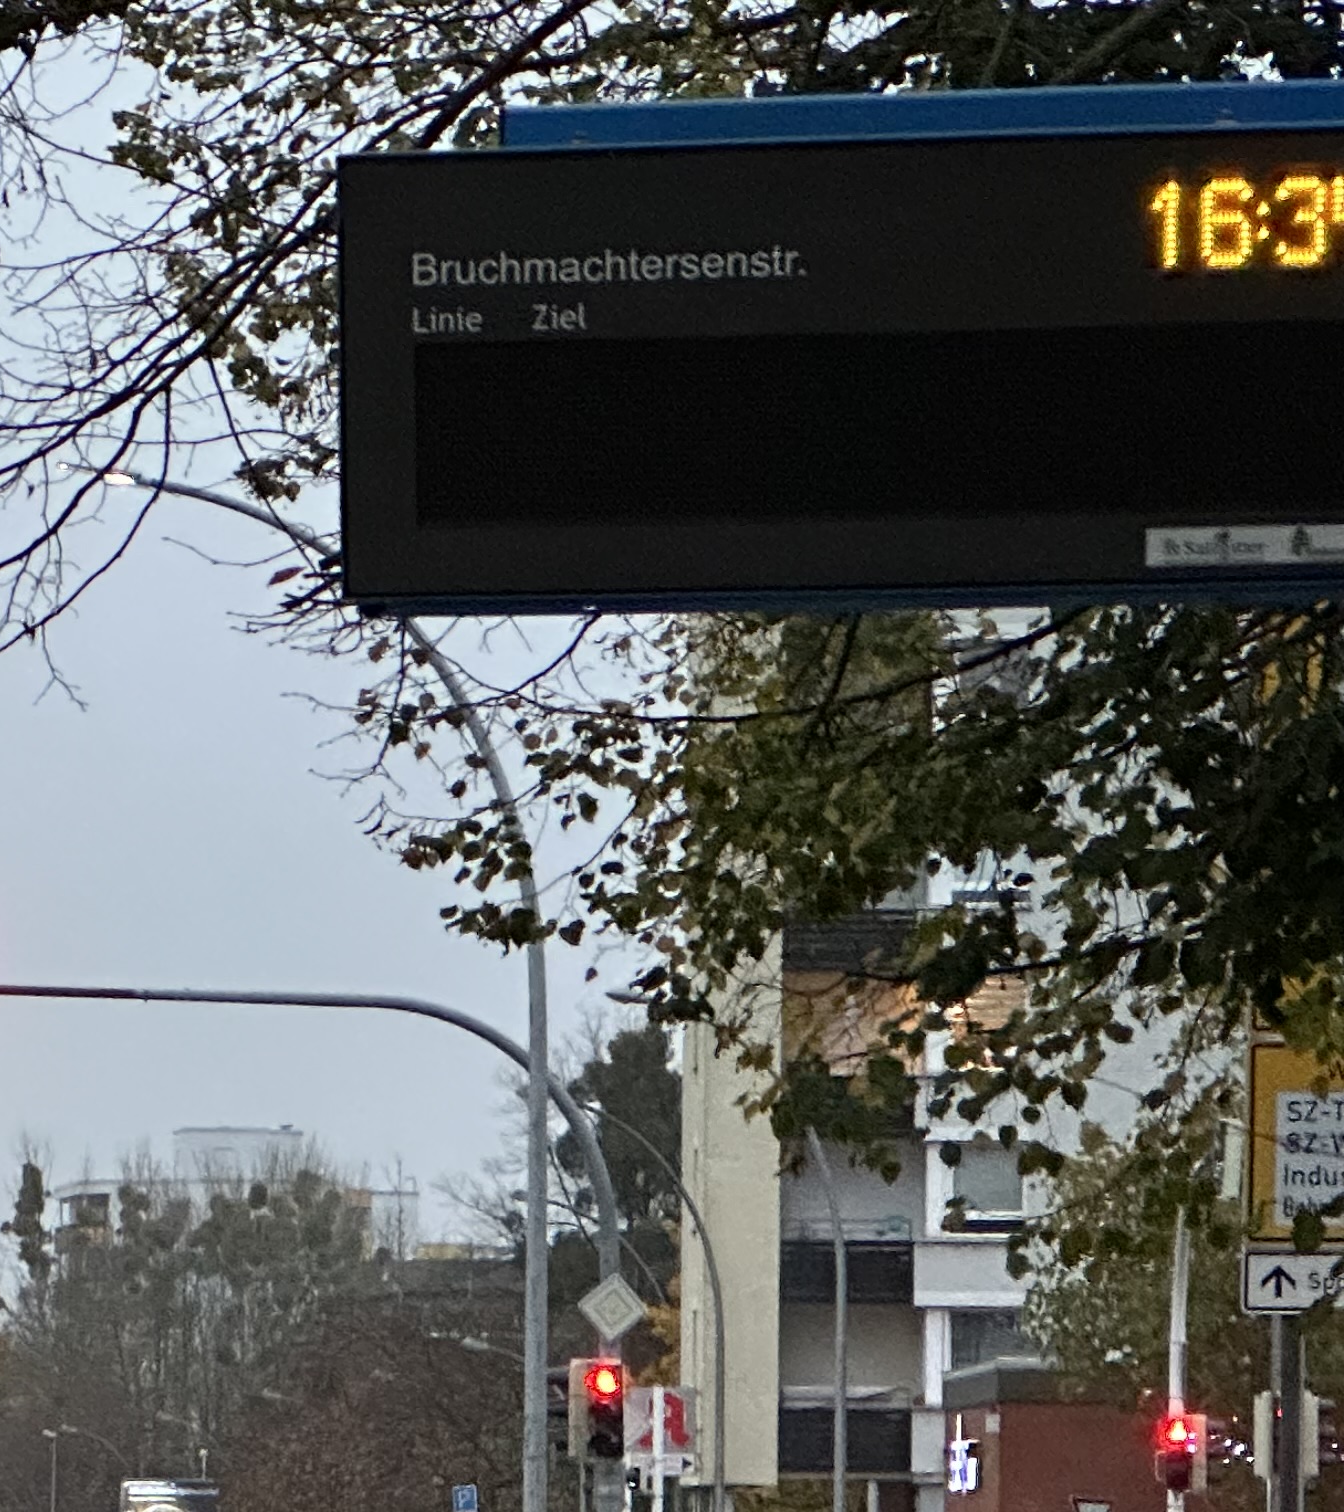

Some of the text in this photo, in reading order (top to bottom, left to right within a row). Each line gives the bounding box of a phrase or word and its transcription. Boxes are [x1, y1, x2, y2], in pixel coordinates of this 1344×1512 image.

[411, 245, 808, 287] Bruchmachtersenstr.
[412, 301, 588, 334] Linie Ziel
[1283, 1163, 1344, 1188] Indu
